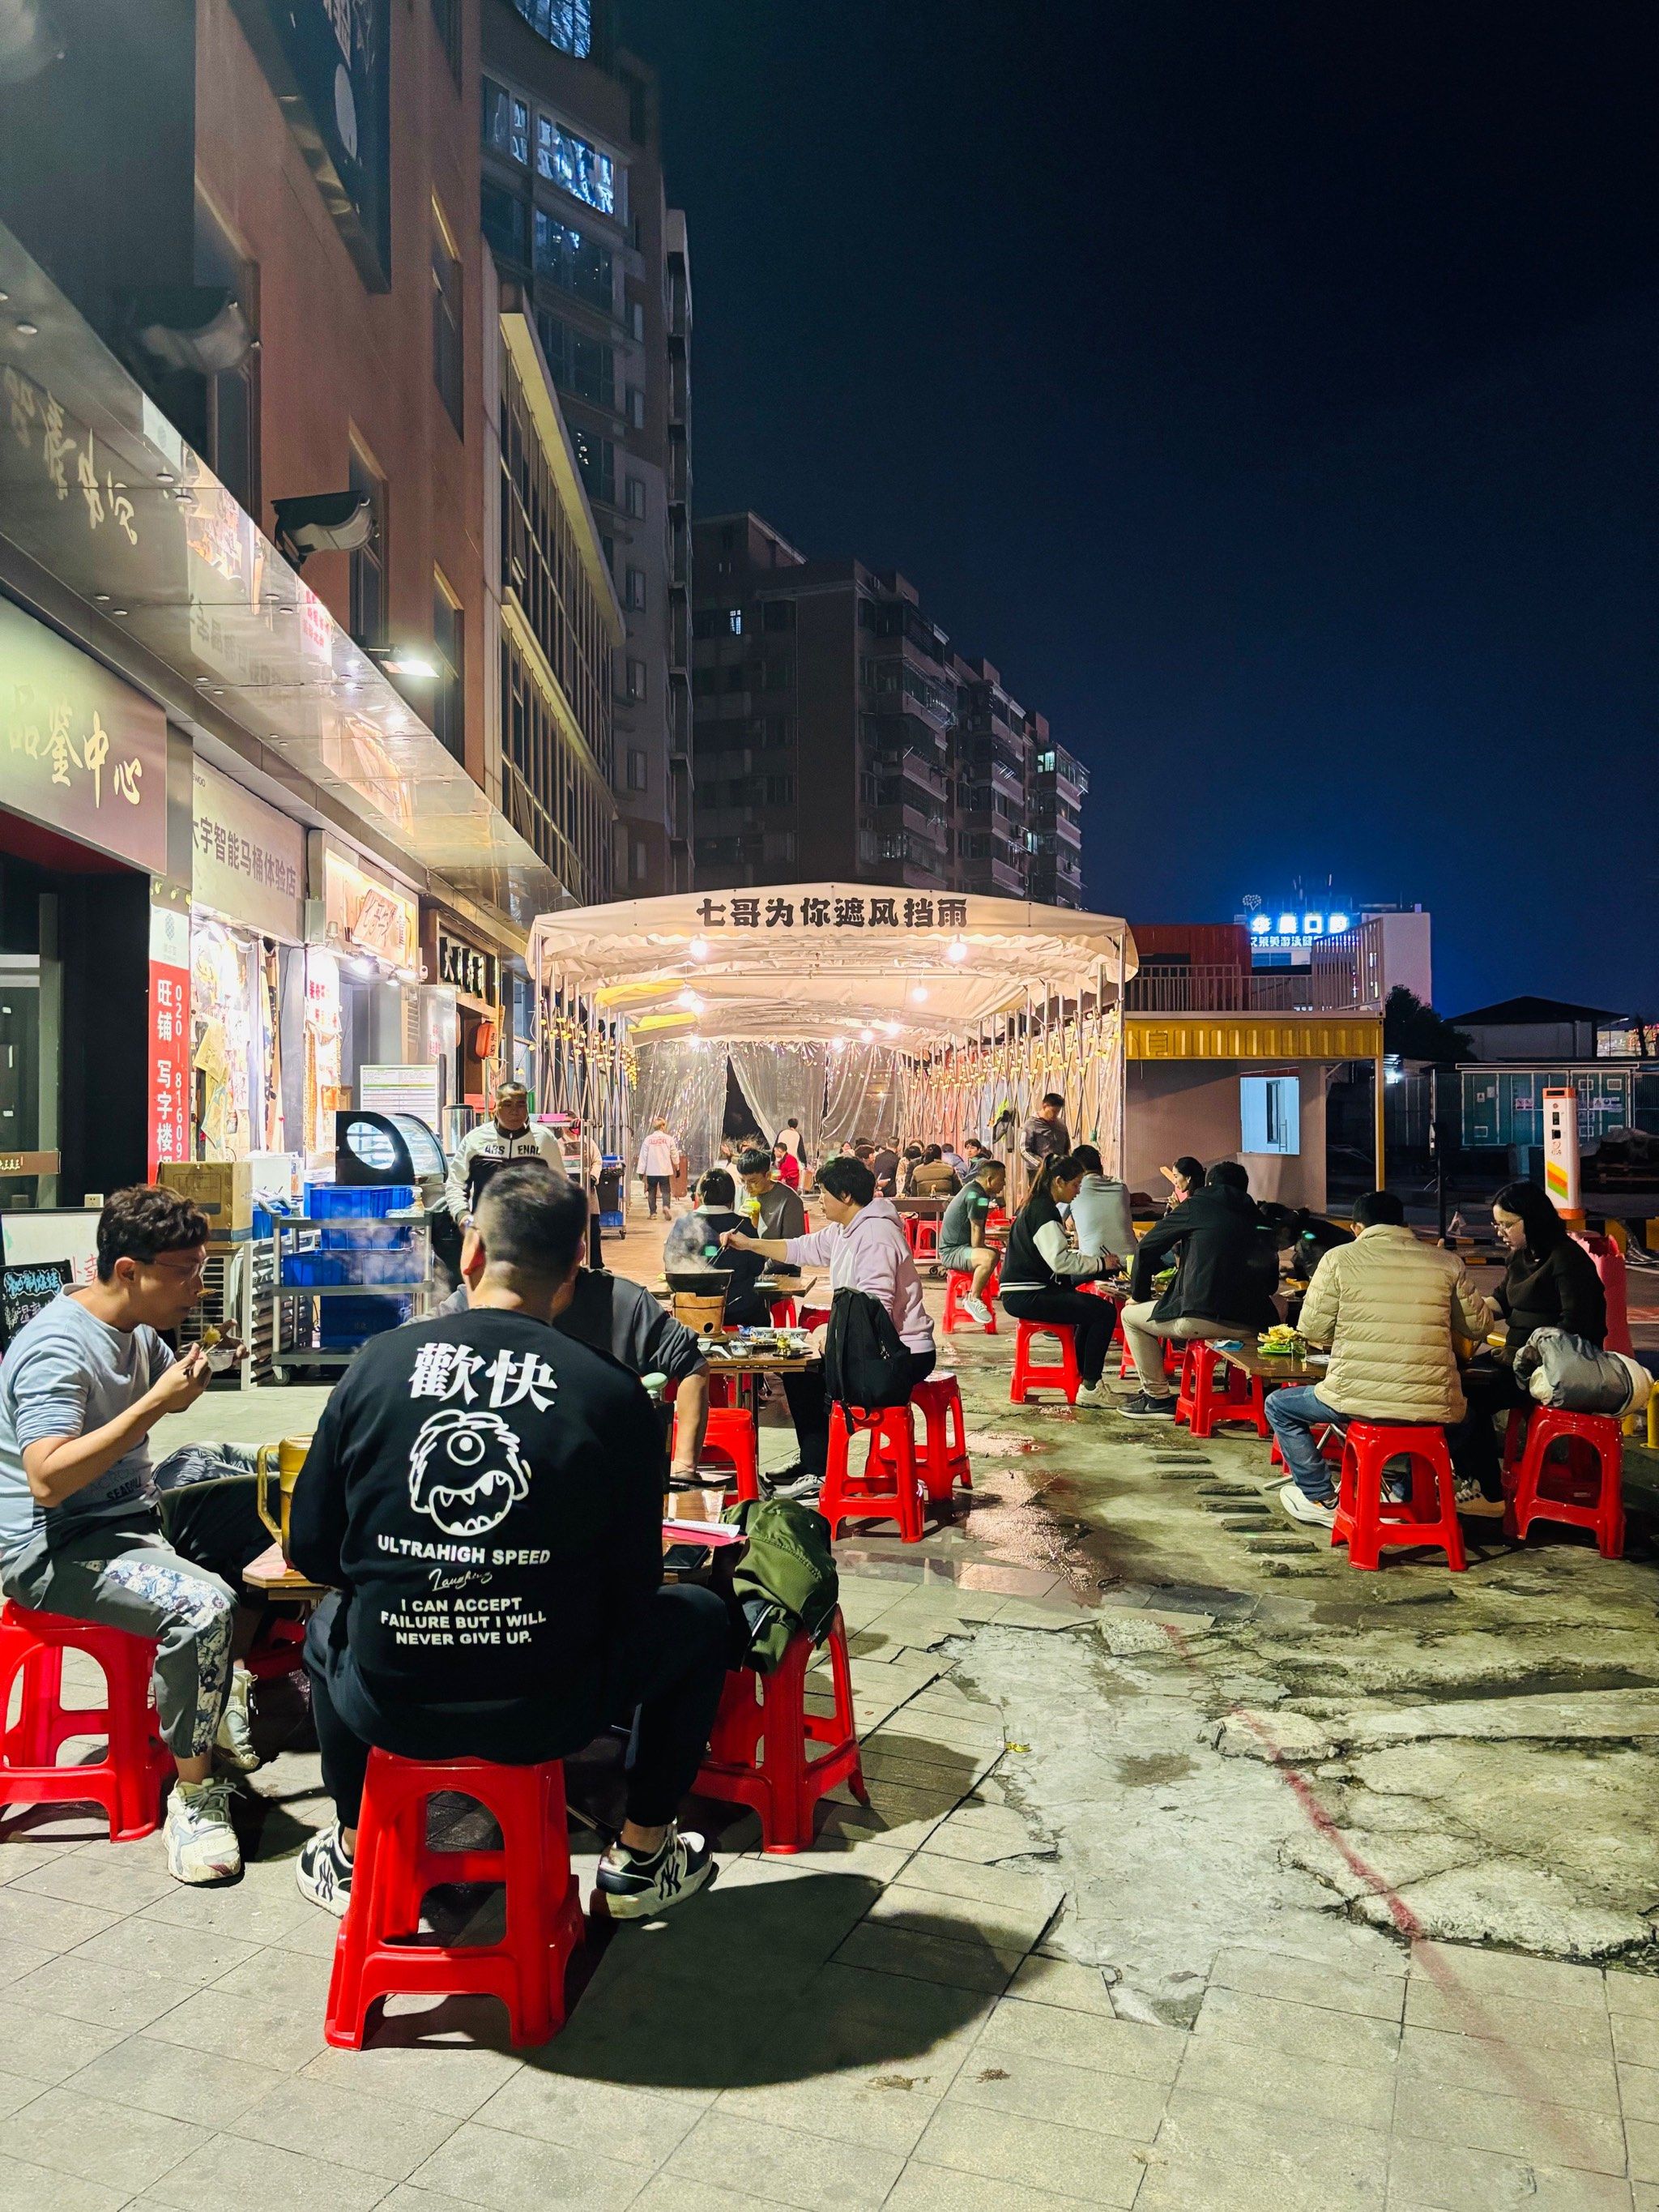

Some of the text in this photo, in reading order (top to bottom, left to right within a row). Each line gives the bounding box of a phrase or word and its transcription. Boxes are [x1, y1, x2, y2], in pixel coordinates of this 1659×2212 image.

[696, 897, 969, 929] 七哥为你遮风挡雨
[408, 1342, 559, 1412] 歡快
[377, 1534, 551, 1565] ULTRAHIGH SPEED
[401, 1597, 522, 1612] I CAN ACCEPT
[381, 1611, 547, 1629] FAILURE BUT I WILL
[395, 1631, 532, 1646] NEVER GIVE UP.
